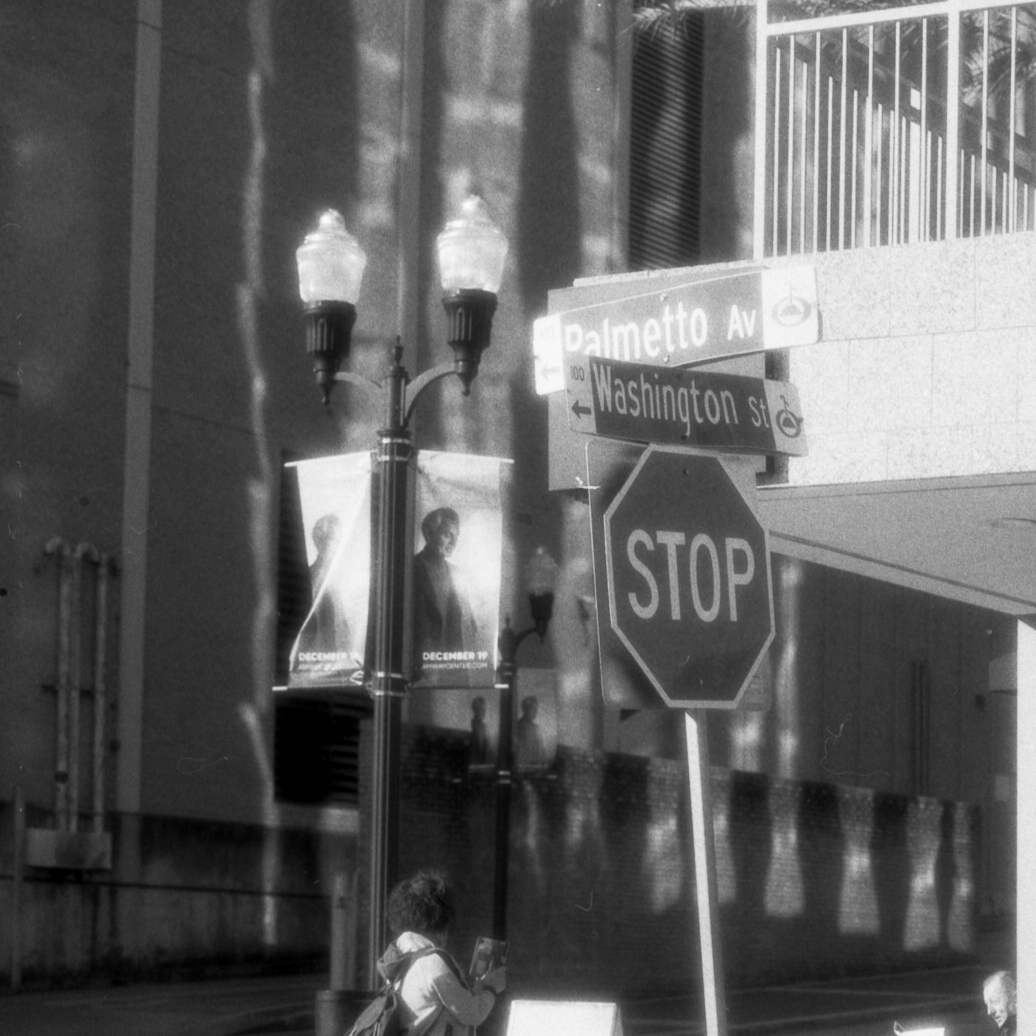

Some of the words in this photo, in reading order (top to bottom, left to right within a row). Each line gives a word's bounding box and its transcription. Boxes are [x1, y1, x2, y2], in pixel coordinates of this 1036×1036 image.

[565, 301, 708, 362] Palmetto
[570, 365, 585, 382] 100
[592, 362, 740, 438] Washington
[748, 394, 770, 428] St
[627, 528, 755, 622] STOP
[299, 652, 347, 661] DECEMBER
[423, 651, 475, 660] DECEMBER
[477, 651, 488, 660] 19
